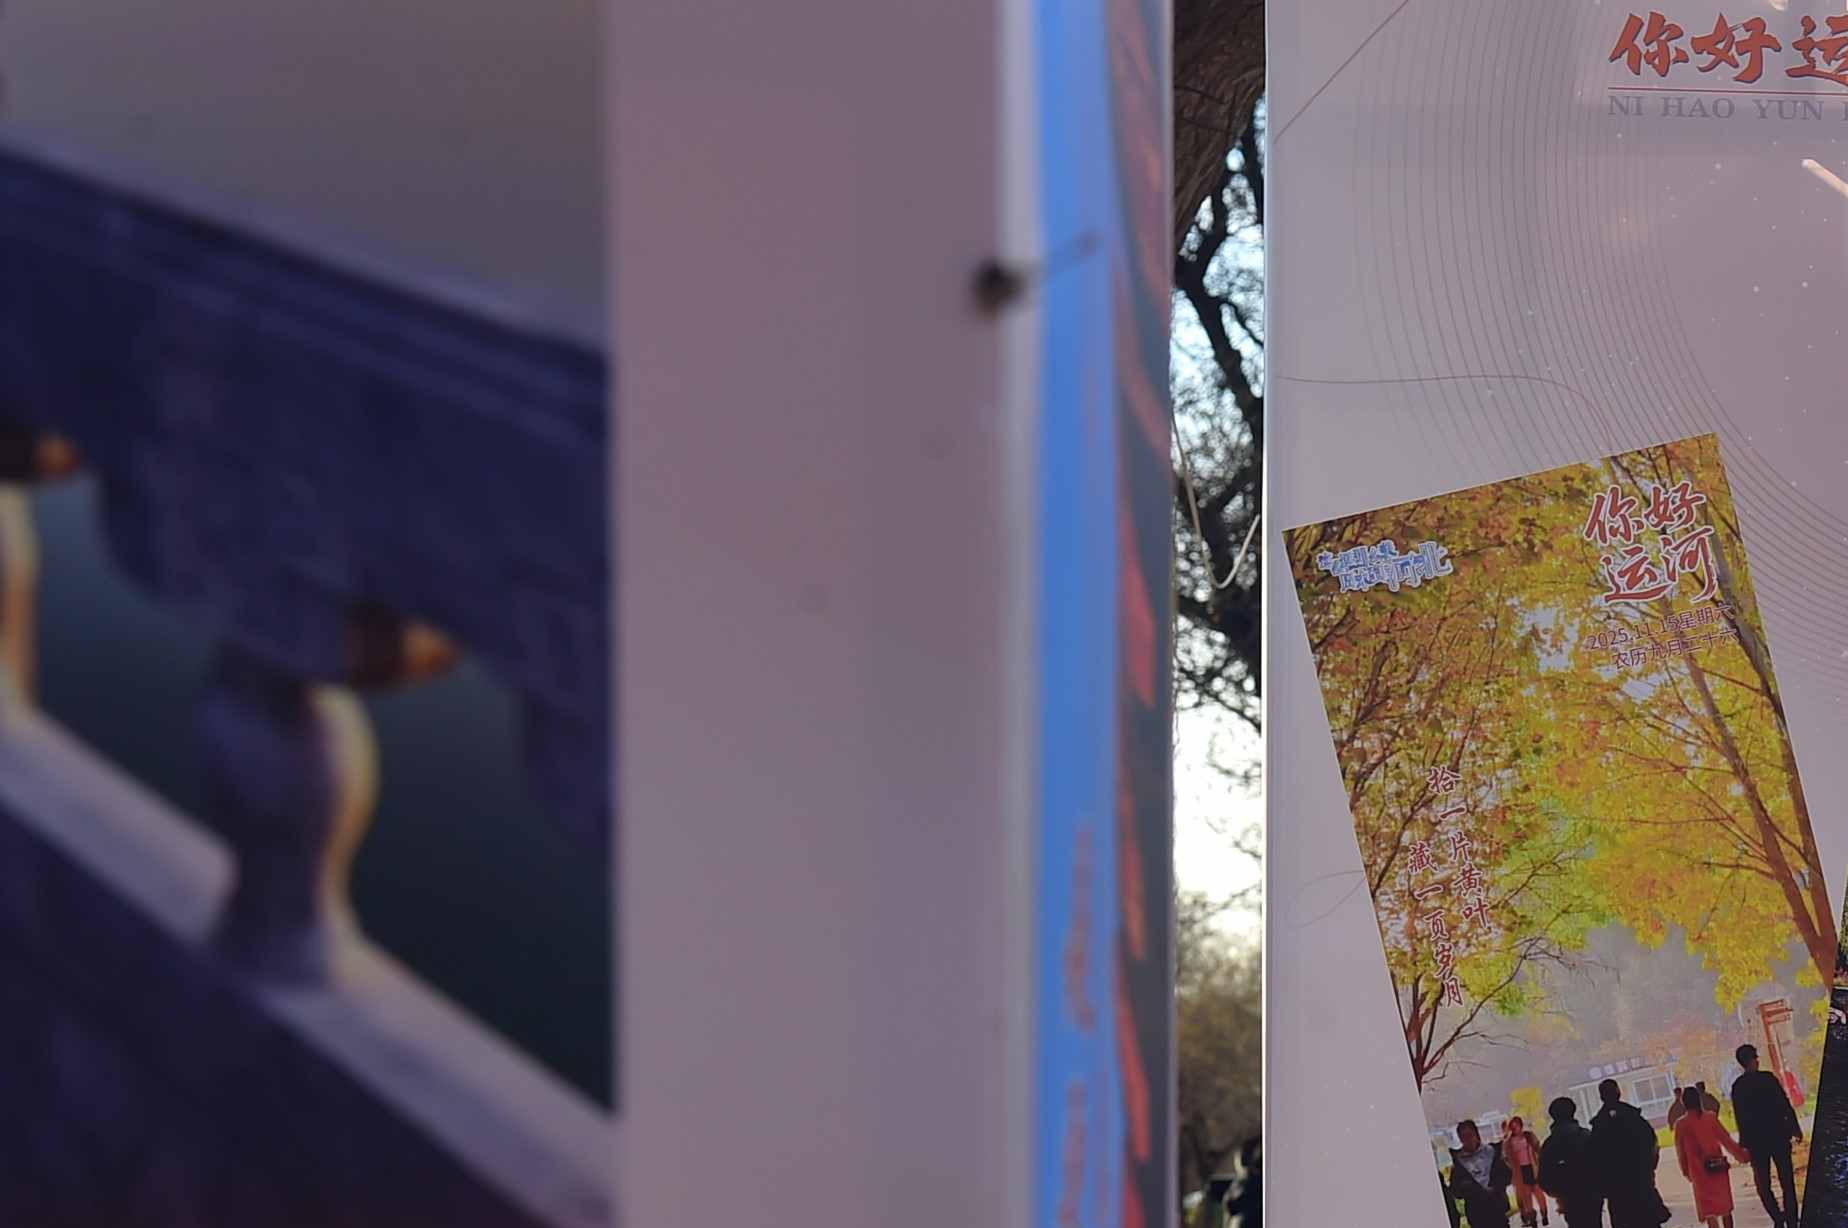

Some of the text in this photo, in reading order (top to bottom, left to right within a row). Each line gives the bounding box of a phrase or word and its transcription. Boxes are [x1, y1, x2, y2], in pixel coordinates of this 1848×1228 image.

[1608, 96, 1643, 116] NI
[1660, 97, 1735, 119] HAO
[1752, 100, 1823, 121] YUN
[1584, 481, 1706, 544] 你好
[1602, 526, 1718, 604] 运河
[1427, 765, 1492, 930] 拾一片黄叶
[1408, 842, 1464, 1007] 藏一页岁月
